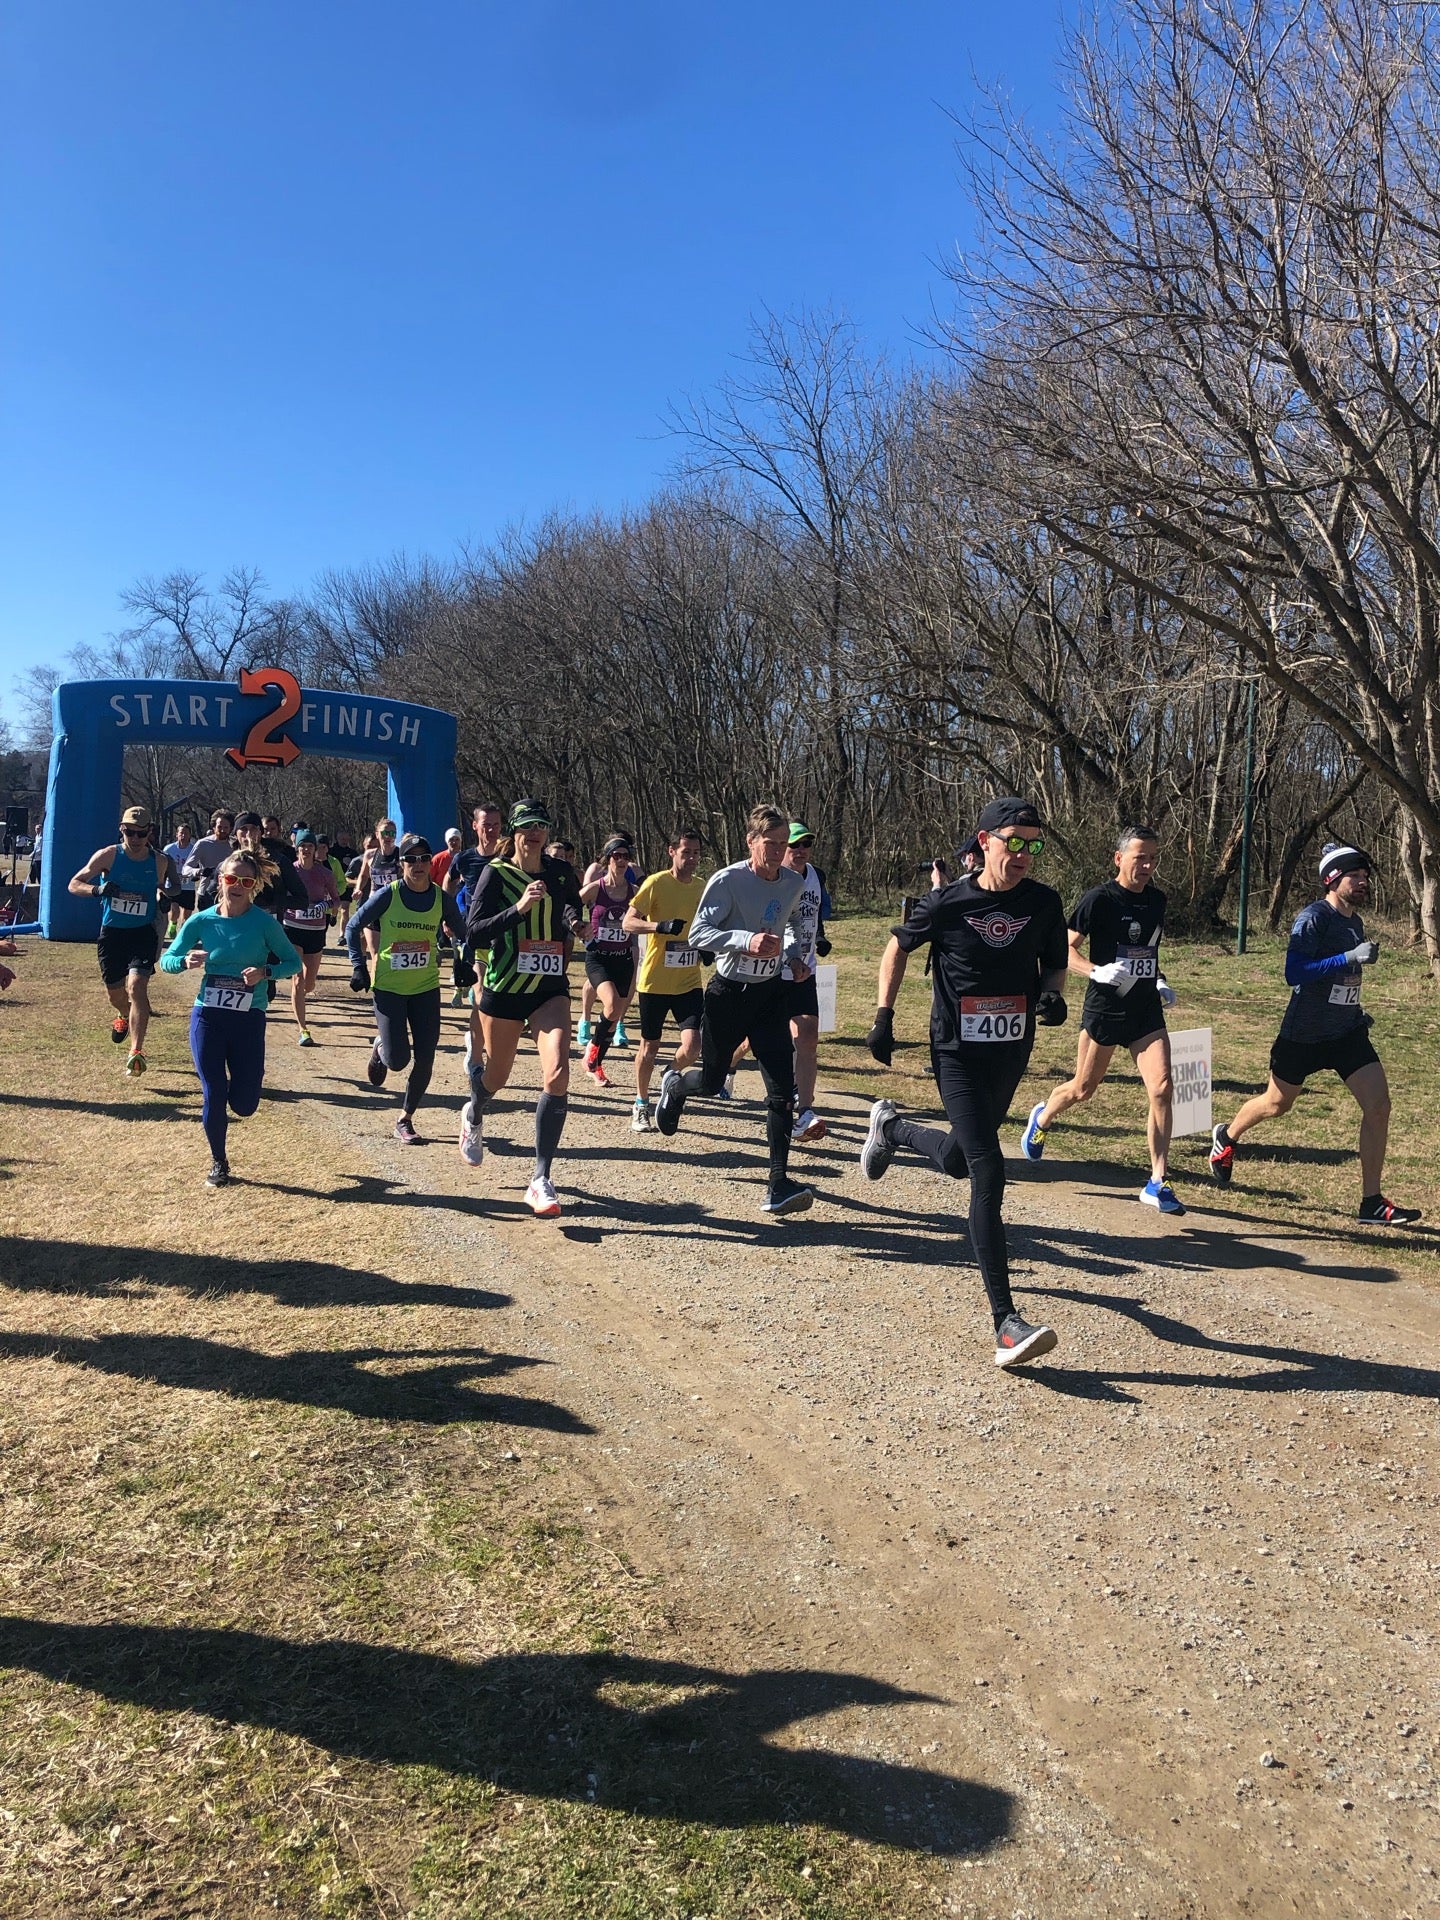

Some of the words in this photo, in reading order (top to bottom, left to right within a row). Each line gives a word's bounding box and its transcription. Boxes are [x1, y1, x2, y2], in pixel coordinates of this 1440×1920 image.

[109, 693, 234, 728] START
[302, 703, 422, 747] FINISH
[800, 890, 819, 905] etic
[122, 900, 140, 914] 171
[302, 909, 321, 919] 448
[397, 921, 437, 931] BODYFLIGHT
[992, 923, 1003, 936] C
[607, 928, 627, 941] 215
[400, 953, 427, 968] 345
[529, 953, 560, 973] 303
[678, 951, 695, 966] 411
[752, 958, 776, 975] 179
[1129, 959, 1152, 976] 183
[216, 989, 246, 1009] 127
[977, 1014, 1022, 1039] 406
